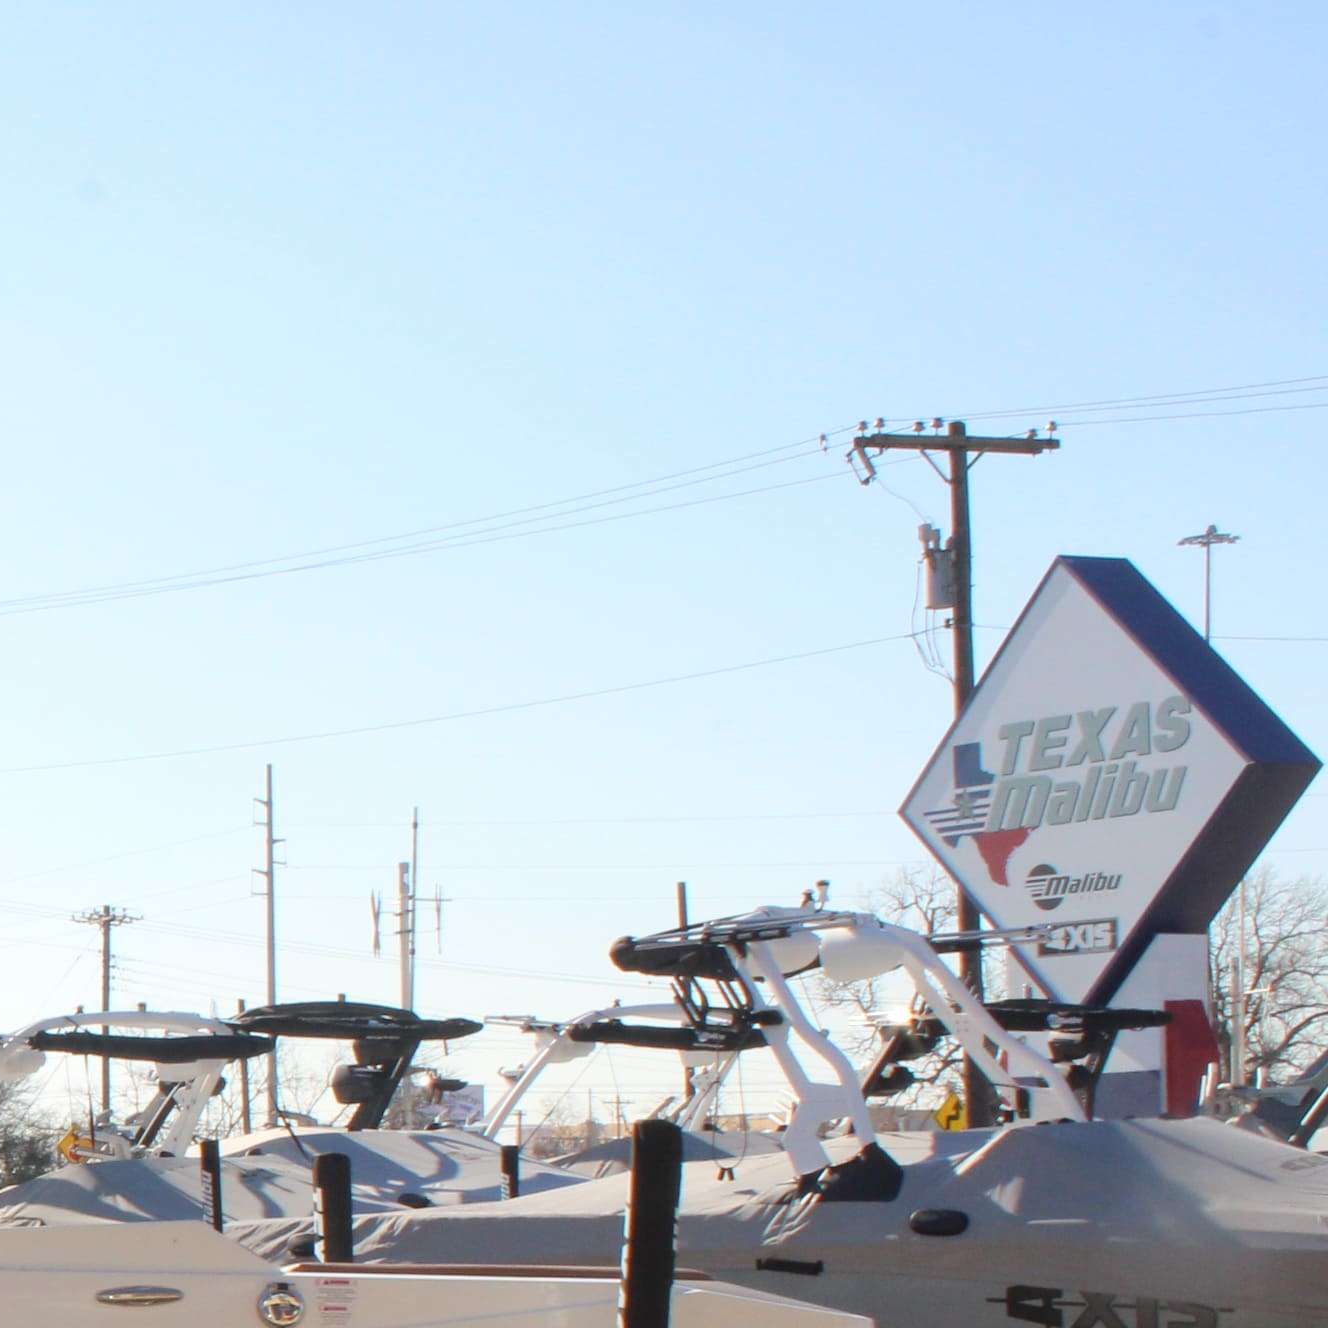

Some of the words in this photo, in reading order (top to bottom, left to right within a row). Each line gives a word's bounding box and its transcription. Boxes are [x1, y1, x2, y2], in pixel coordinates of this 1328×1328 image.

[999, 696, 1192, 776] TEXAS
[988, 761, 1188, 832] Malibu
[1045, 872, 1123, 897] Malibu
